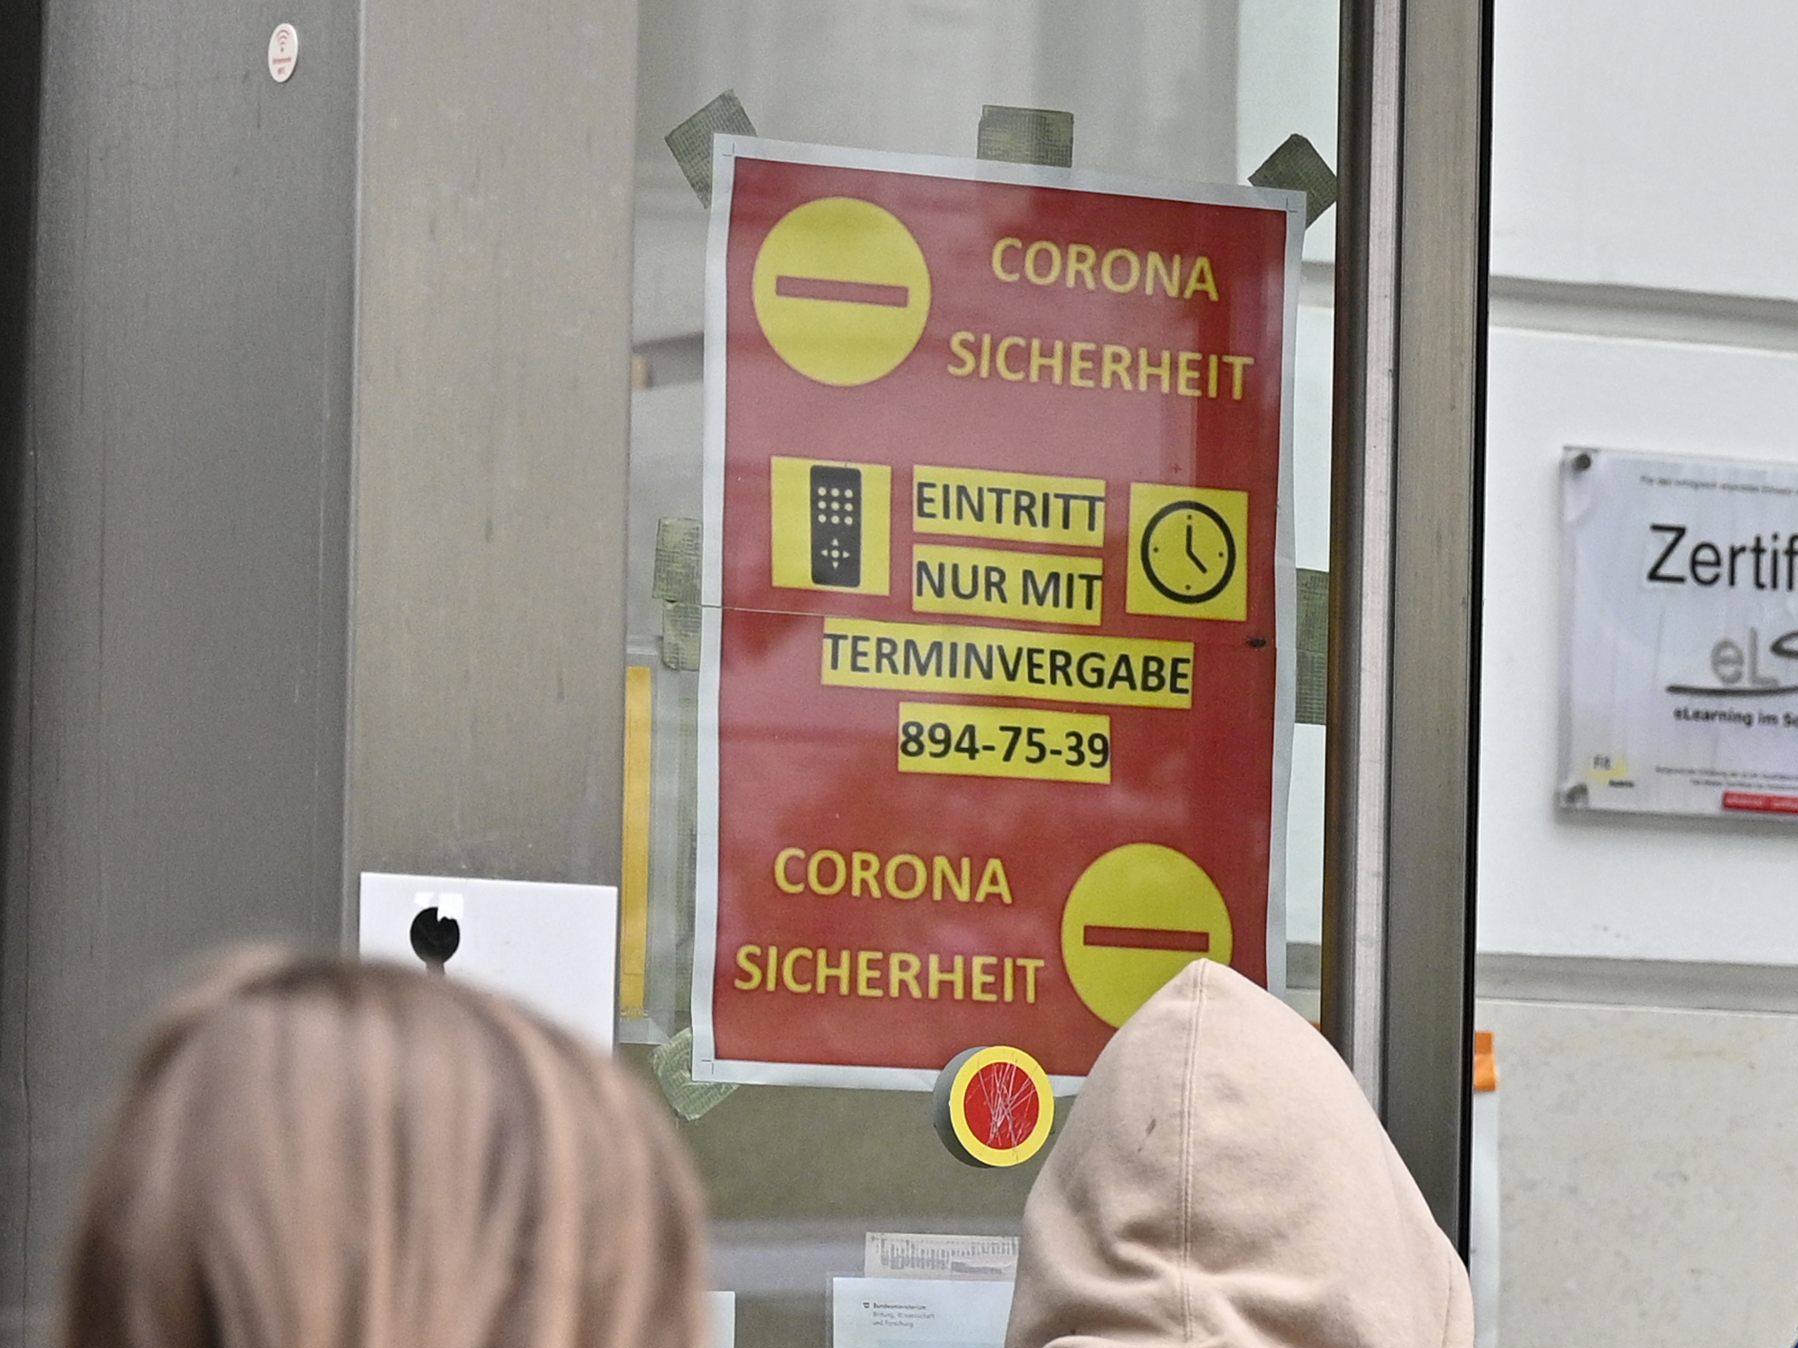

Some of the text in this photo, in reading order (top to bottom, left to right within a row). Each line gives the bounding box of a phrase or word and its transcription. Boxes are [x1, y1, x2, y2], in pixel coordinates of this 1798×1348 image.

[990, 236, 1220, 303] CORONA
[946, 330, 1254, 400] SICHERHEIT
[915, 481, 1105, 533] EINTRITT
[915, 559, 1104, 611] NUR MIT
[823, 632, 1192, 695] TERMINVERGABE
[899, 720, 1110, 769] 894-75-39
[1673, 706, 1754, 728] eLearning
[1757, 710, 1779, 726] im
[773, 846, 1013, 905] CORONA
[733, 943, 1046, 1005] SICHERHEIT
